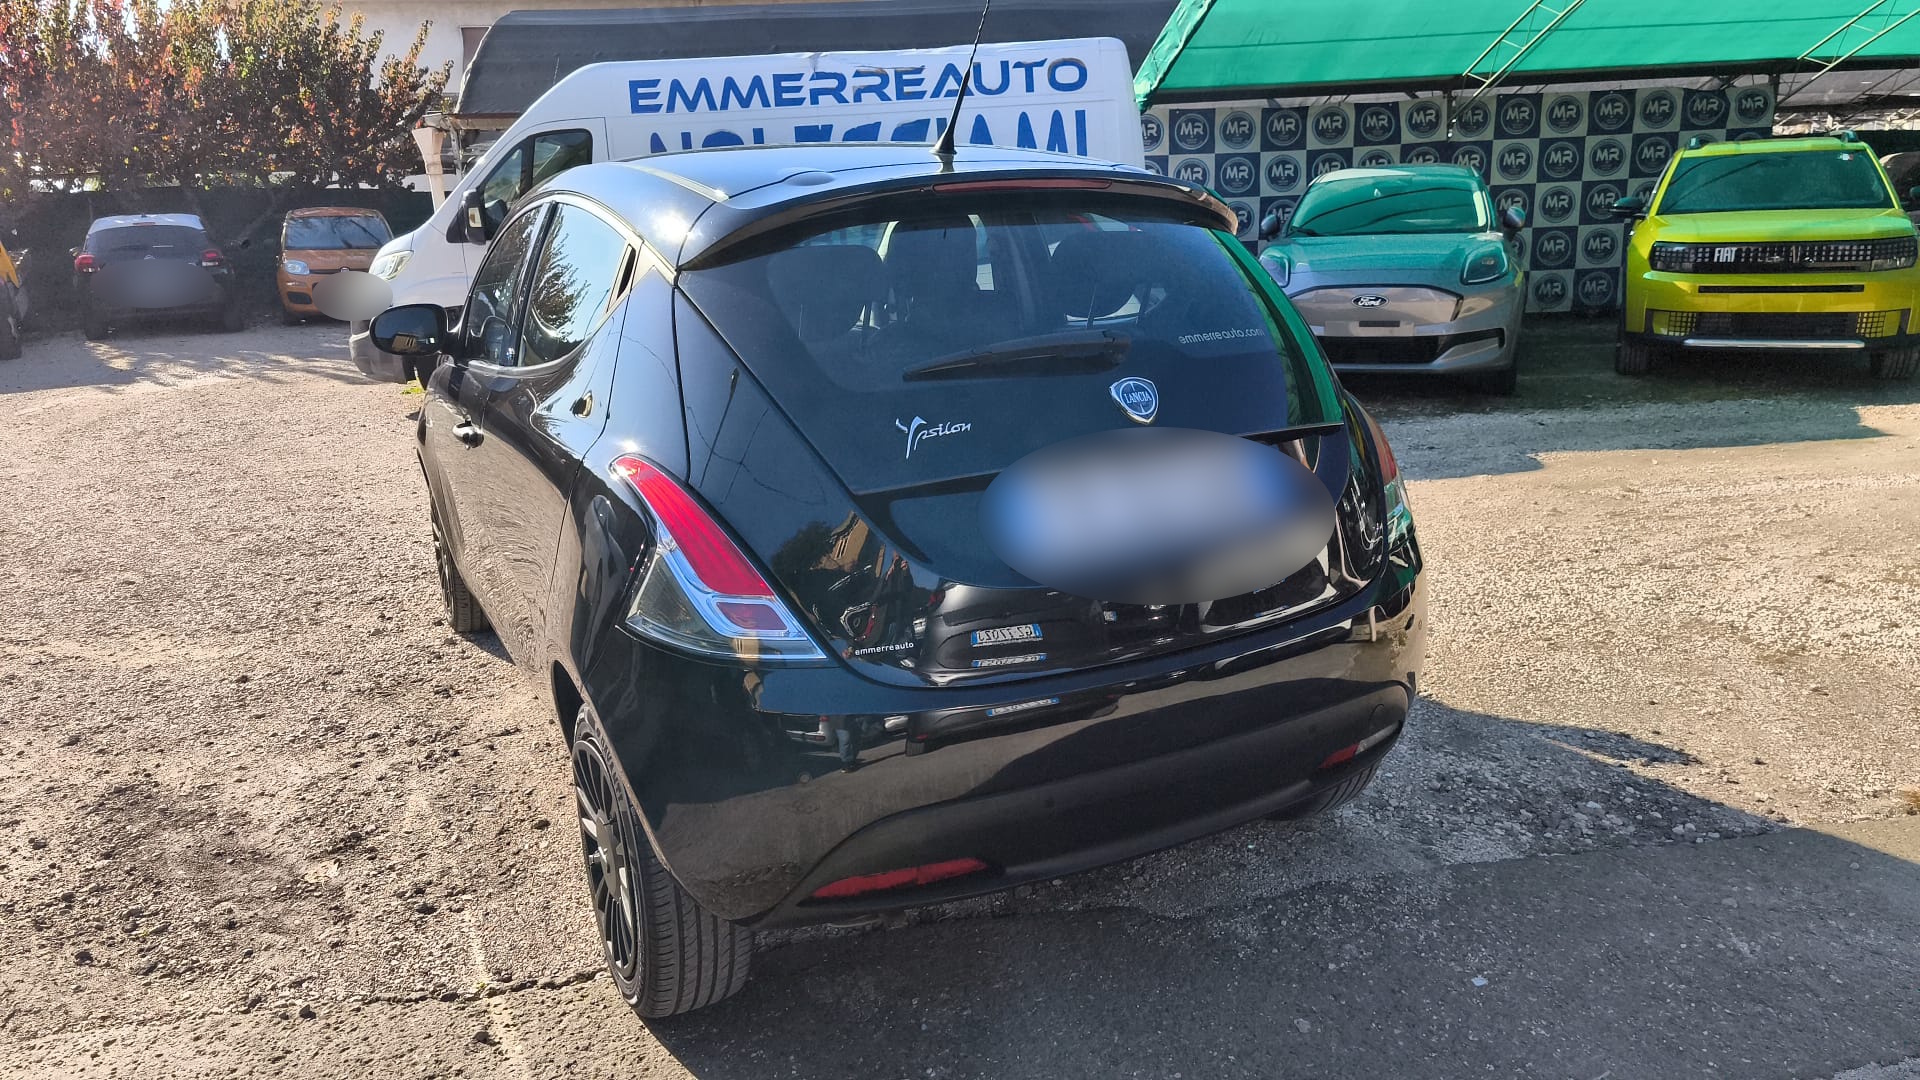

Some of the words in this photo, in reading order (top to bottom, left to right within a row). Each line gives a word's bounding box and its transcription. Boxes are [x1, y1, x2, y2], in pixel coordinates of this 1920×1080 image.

[628, 57, 1088, 114] EMMERREAUTO
[1600, 102, 1624, 116] MR
[1645, 99, 1671, 114] MR
[1693, 98, 1719, 112] MR
[1741, 96, 1764, 109] MR
[1412, 109, 1437, 124] MR
[1462, 109, 1484, 123] MR
[1506, 106, 1530, 121] MR
[1552, 104, 1577, 119] MR
[1226, 120, 1250, 134] MR
[1272, 118, 1296, 132] MR
[1318, 115, 1342, 130] MR
[1366, 114, 1388, 127] MR
[1180, 122, 1204, 136] MR
[1503, 152, 1526, 166] MR
[1549, 150, 1573, 164] MR
[1595, 147, 1620, 162] MR
[1641, 145, 1666, 160] MR
[1457, 154, 1480, 167] MR
[1180, 167, 1203, 181] MR
[1226, 165, 1249, 179] MR
[1271, 164, 1295, 177] MR
[1545, 194, 1569, 209] MR
[1592, 191, 1616, 206] MR
[1542, 242, 1566, 254] MR
[1587, 237, 1612, 251] MR
[1713, 247, 1738, 262] FIAT
[1538, 282, 1562, 296] MR
[1584, 279, 1608, 293] MR
[1357, 295, 1382, 306] Ford
[1178, 326, 1265, 344] emmerreauto.com
[1124, 391, 1152, 404] LANCIA
[896, 416, 972, 459] Ypsilon
[855, 641, 915, 656] emmerreauto
